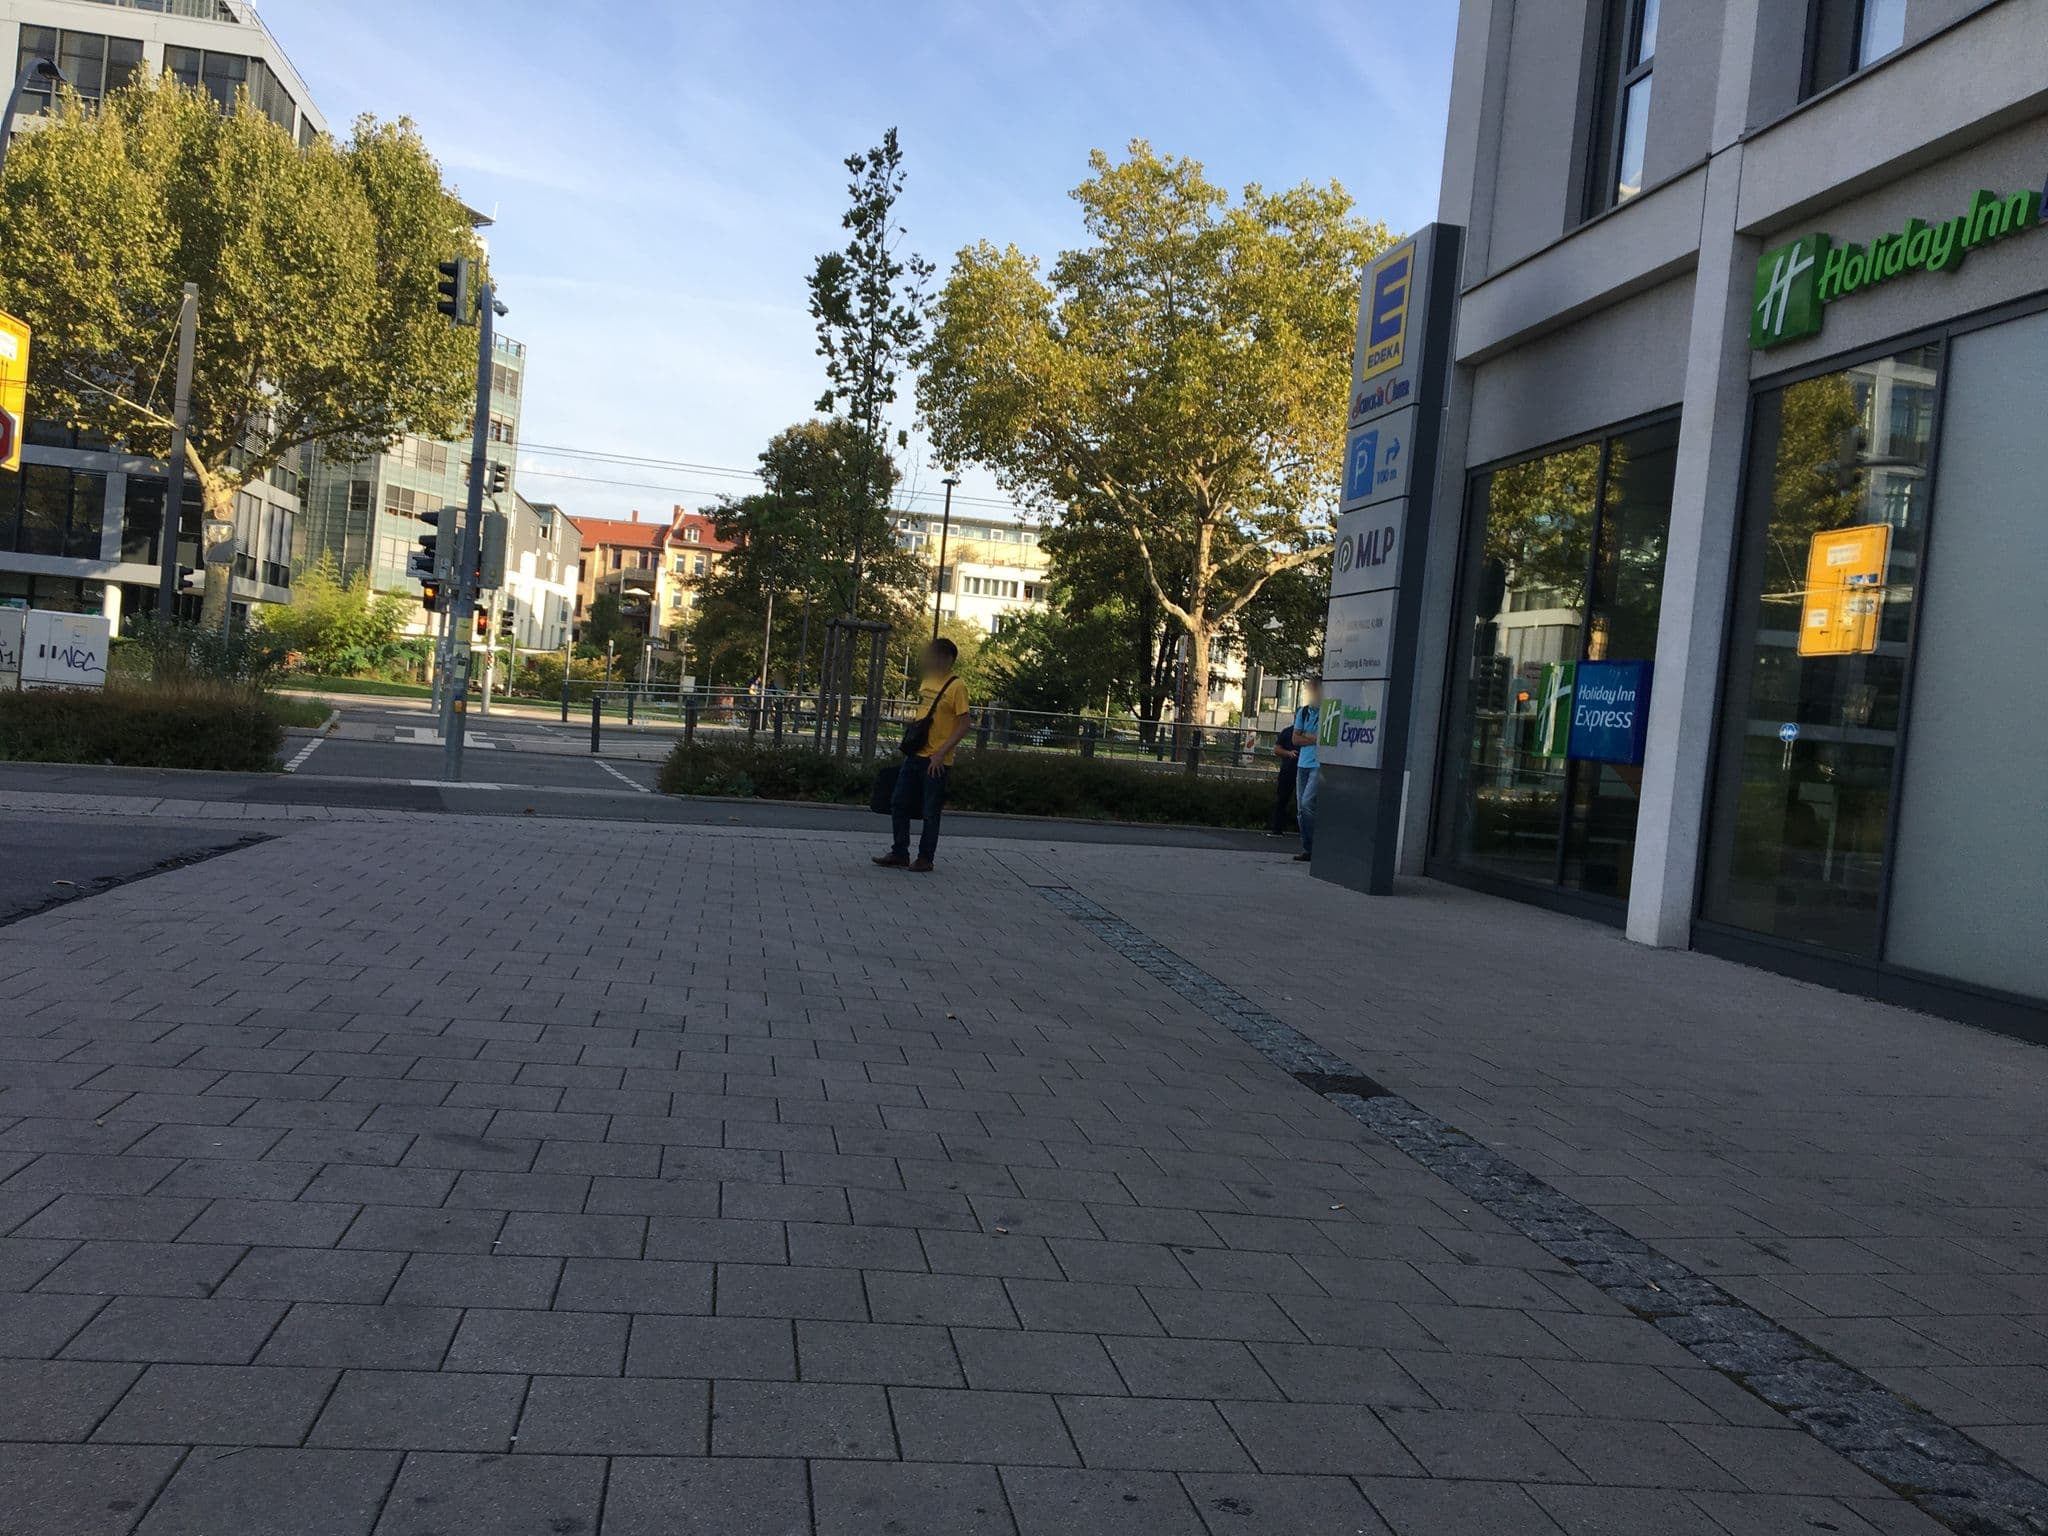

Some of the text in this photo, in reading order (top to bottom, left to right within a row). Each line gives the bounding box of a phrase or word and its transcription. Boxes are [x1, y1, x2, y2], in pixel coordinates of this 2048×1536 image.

[1819, 217, 1961, 300] Holiday
[1961, 189, 2032, 247] Inn
[1367, 342, 1400, 369] EDEKA
[1354, 450, 1368, 491] P
[1355, 526, 1395, 569] MLP
[1578, 685, 1636, 705] Holiday Inn
[1575, 705, 1633, 732] Express
[1341, 722, 1375, 748] Express
